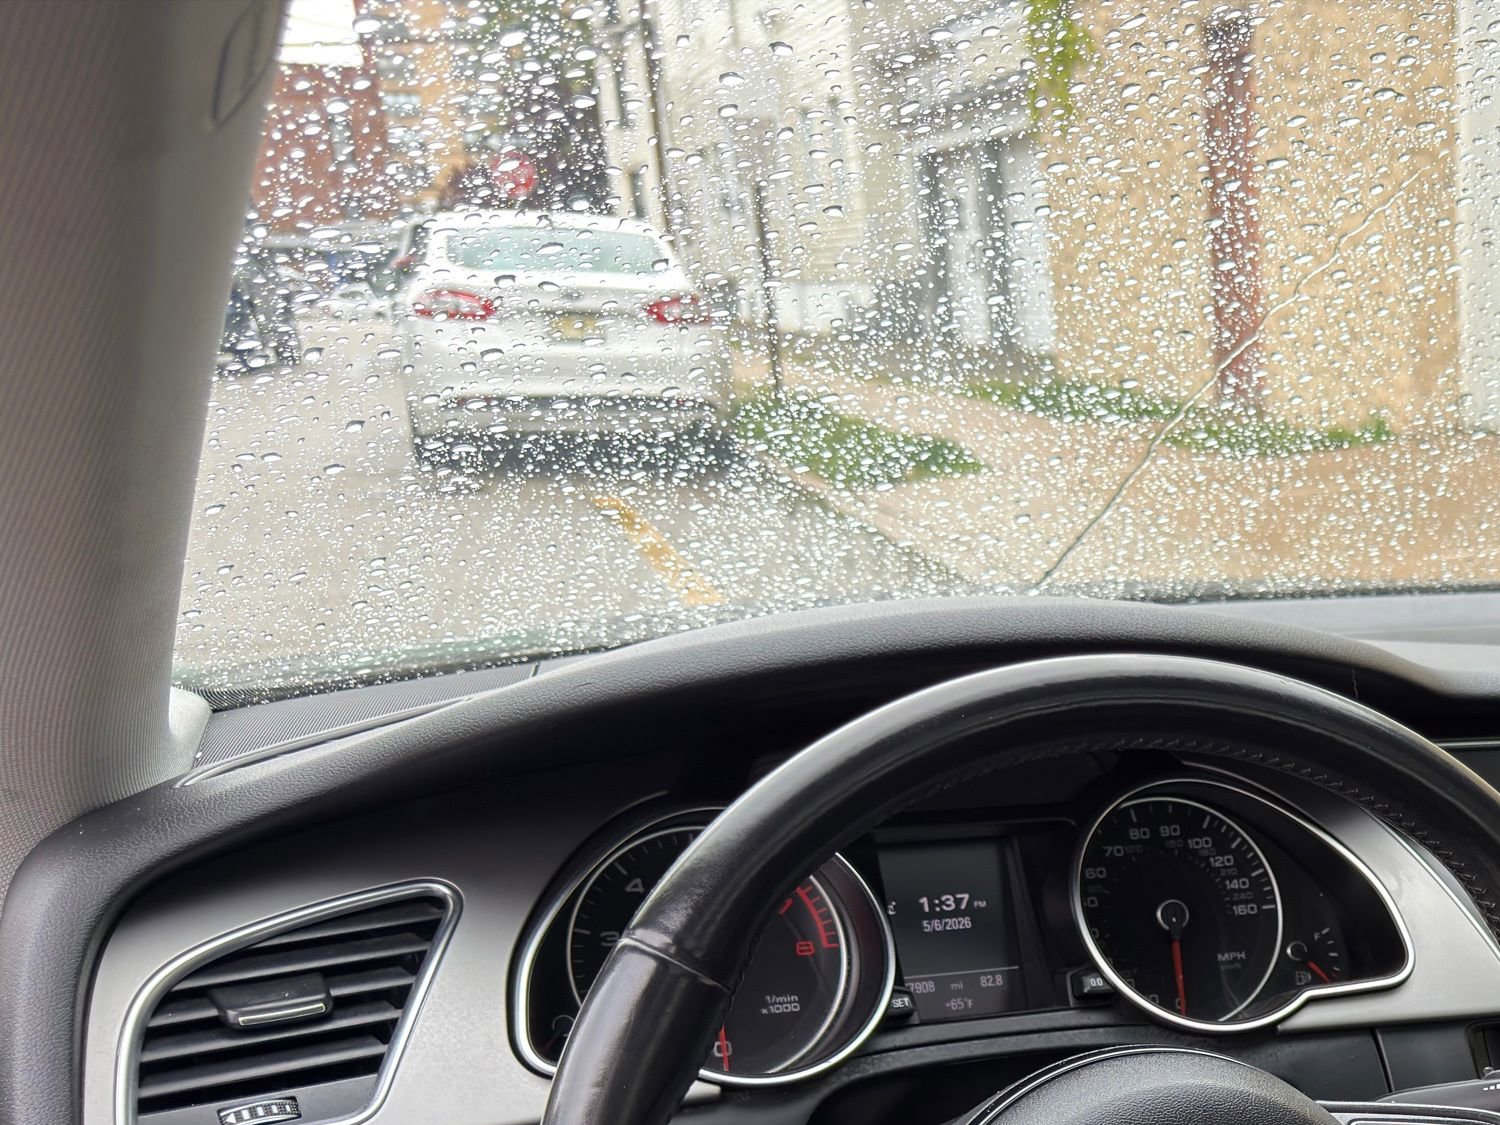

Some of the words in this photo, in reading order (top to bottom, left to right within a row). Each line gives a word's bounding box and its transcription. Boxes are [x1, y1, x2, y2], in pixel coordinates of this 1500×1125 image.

[1129, 827, 1150, 840] 80
[1159, 824, 1181, 838] 90
[1187, 837, 1213, 850] 100
[1103, 845, 1124, 858] 70
[1209, 855, 1235, 868] 120
[1085, 867, 1107, 879] 60
[625, 878, 646, 895] 4
[1225, 877, 1250, 890] 140
[918, 893, 970, 914] 1:37
[1232, 904, 1258, 917] 160
[922, 916, 973, 933] 5/6/2026
[1217, 951, 1246, 963] MPH
[980, 974, 1004, 988] 82.8
[892, 997, 911, 1008] SET
